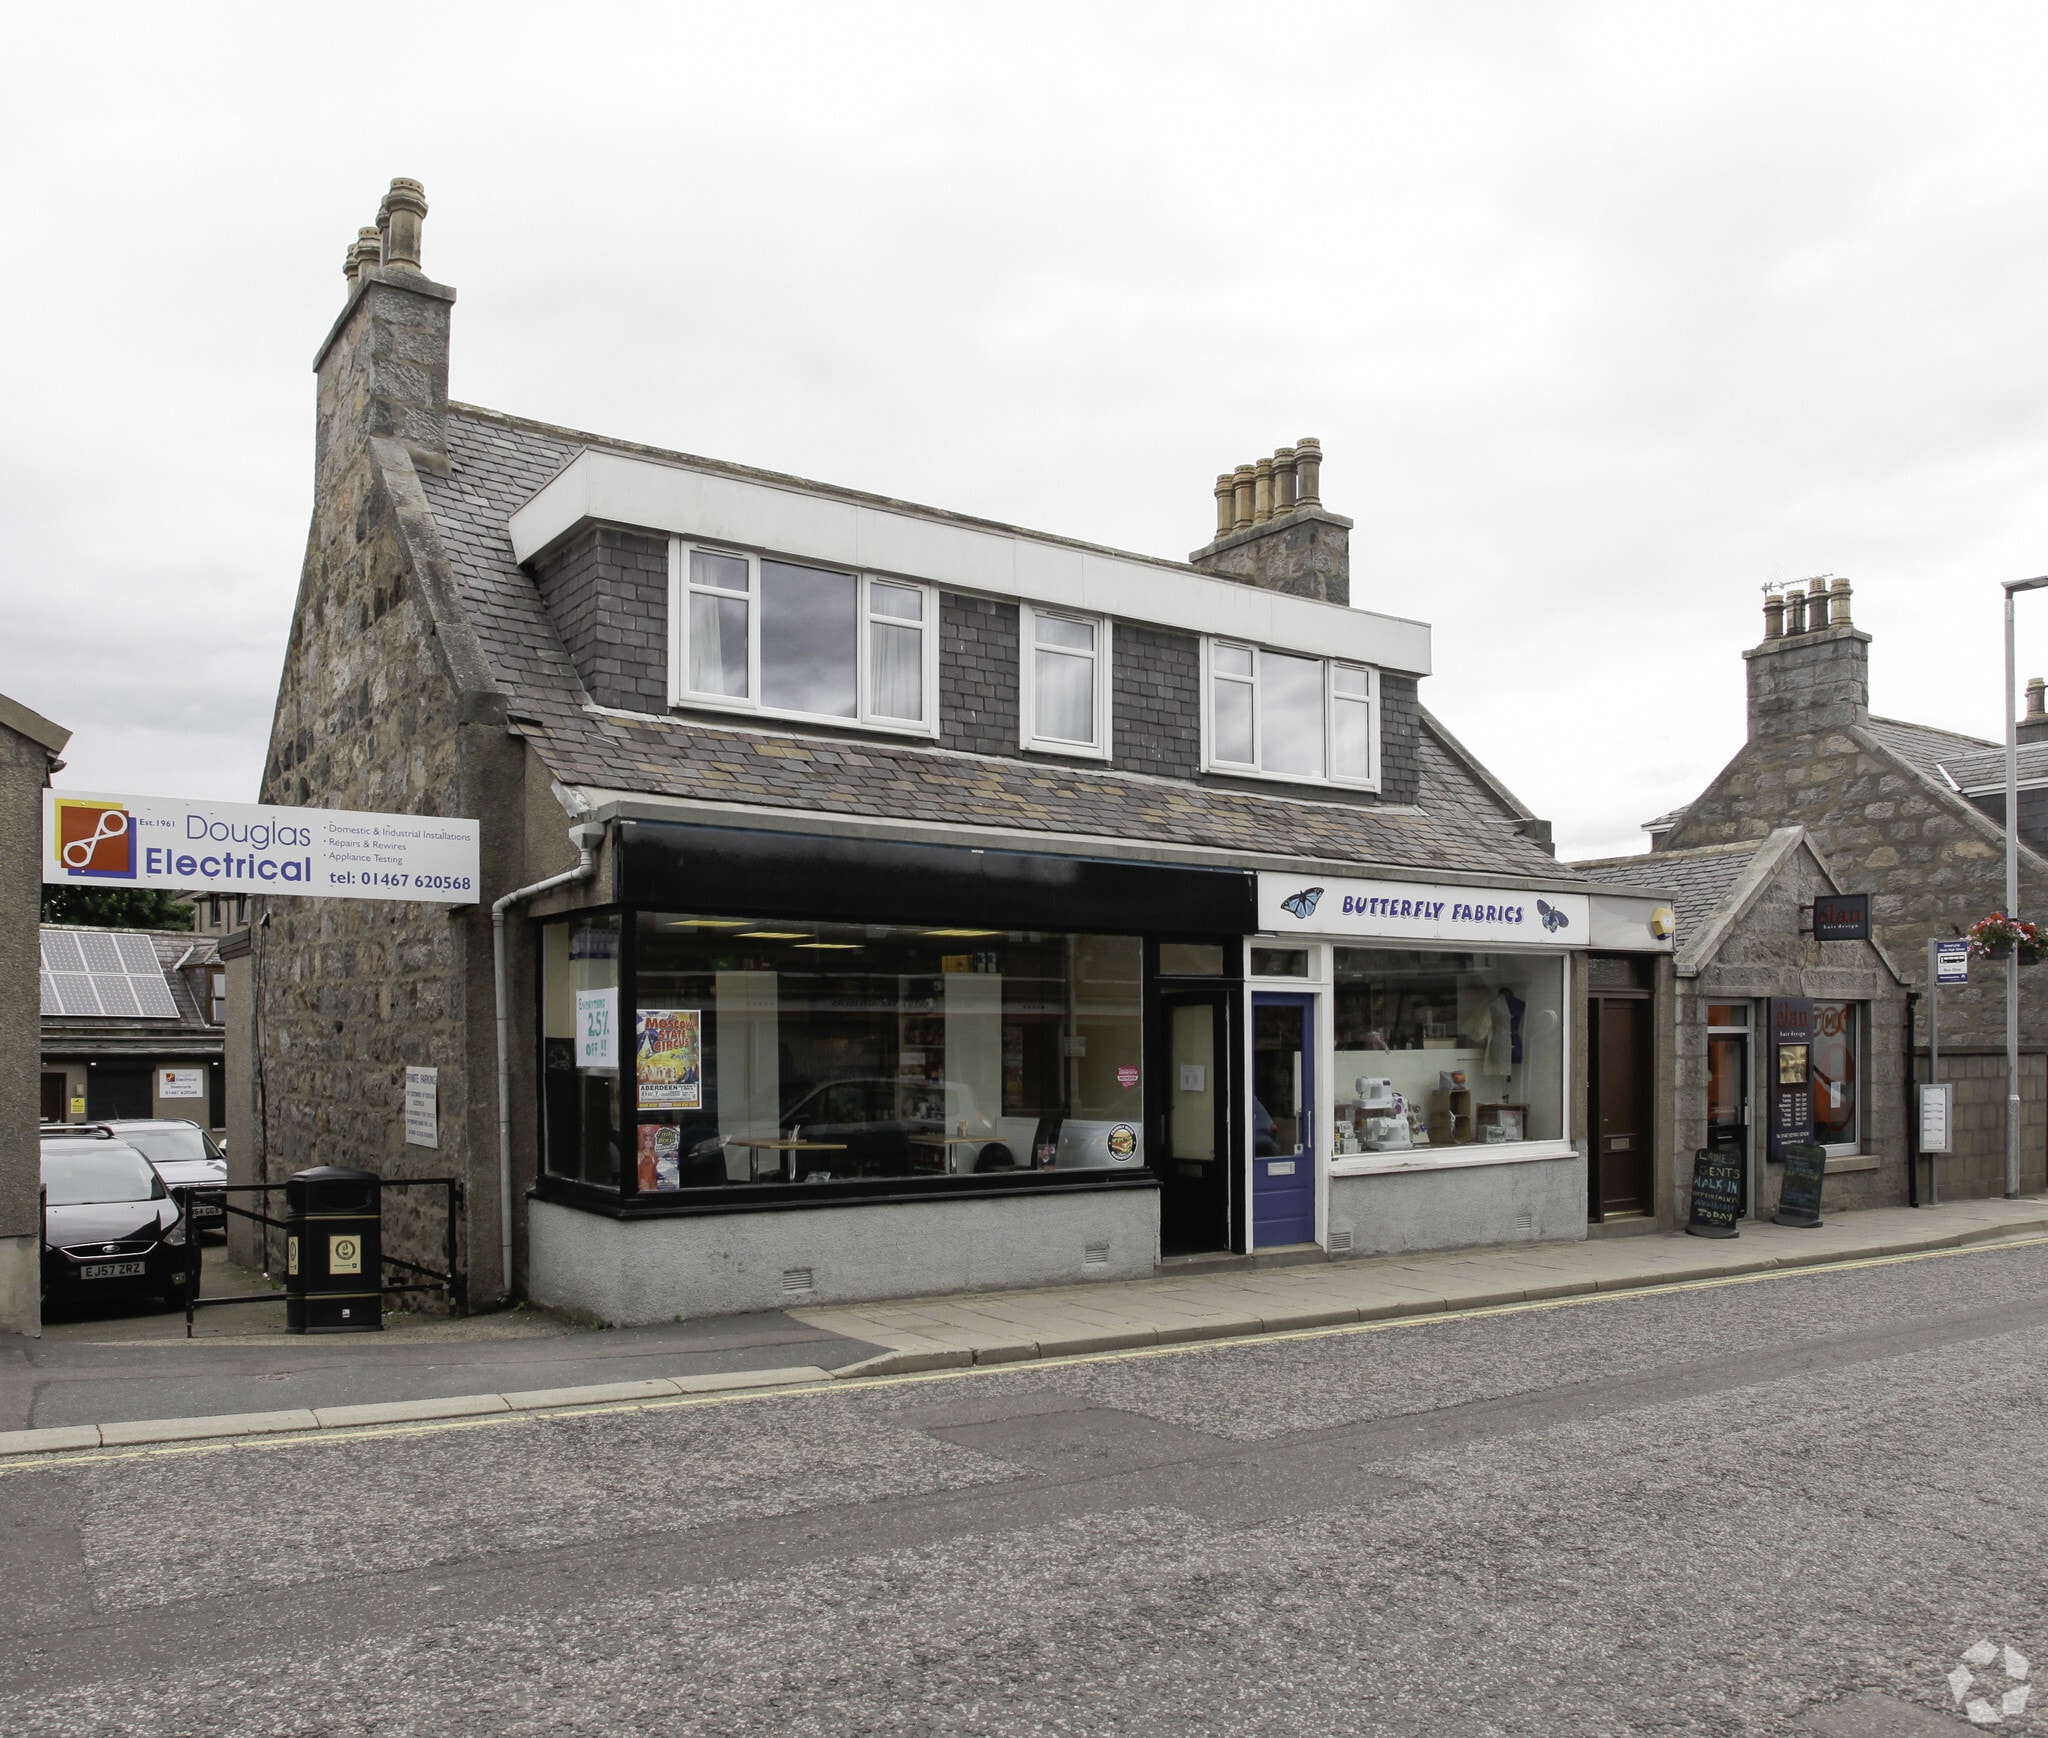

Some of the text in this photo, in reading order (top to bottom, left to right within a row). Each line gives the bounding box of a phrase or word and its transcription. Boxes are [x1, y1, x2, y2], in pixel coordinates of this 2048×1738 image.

[139, 818, 176, 828] Est.1961
[186, 814, 311, 850] Douglas
[329, 824, 471, 842] Domestic & Industrial Installations
[329, 838, 407, 851] Repairs & Rewires
[146, 847, 311, 882] Electrical
[329, 851, 403, 866] Appliance Testing
[329, 871, 471, 890] tel: 01467 620568
[1342, 895, 1524, 924] BUTTERFLY FABRICS
[588, 1010, 610, 1037] 25%
[645, 1017, 693, 1030] MOSCOW
[658, 1029, 687, 1040] STATE
[585, 1042, 598, 1057] OFF
[653, 1038, 689, 1053] CIRCUS
[1699, 1165, 1741, 1180] GENTS
[1697, 1208, 1733, 1222] TODAY
[86, 1263, 141, 1278] EJ57 ZRZ
